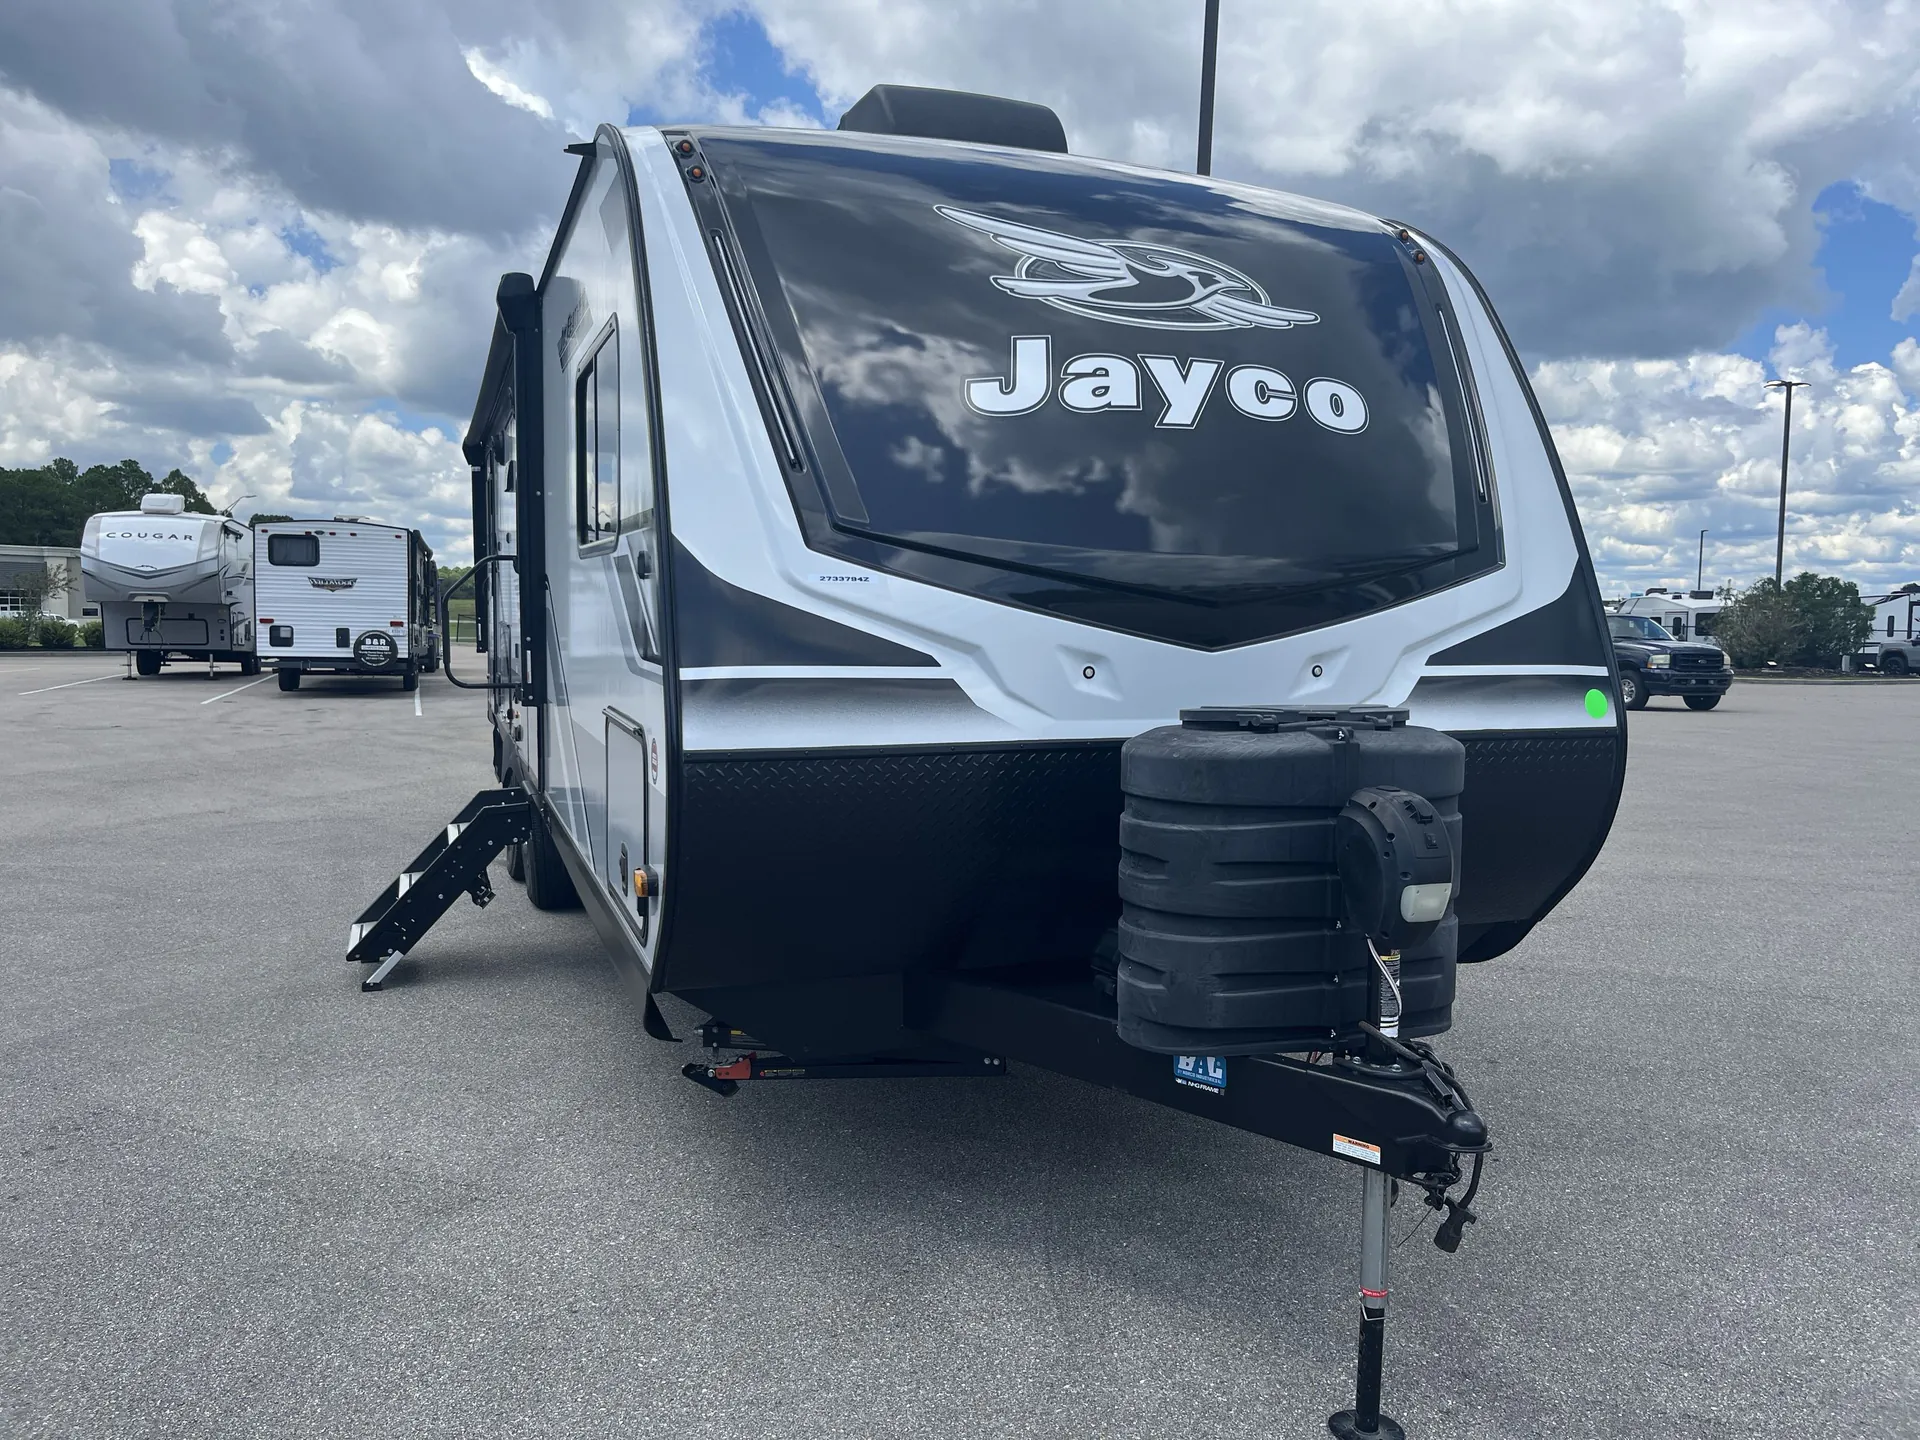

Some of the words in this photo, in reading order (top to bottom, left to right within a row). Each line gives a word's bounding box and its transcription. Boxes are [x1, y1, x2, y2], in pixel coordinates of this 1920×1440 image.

[965, 334, 1370, 435] Jayco
[106, 532, 193, 541] COUGAR
[1348, 1139, 1370, 1149] WARNING
